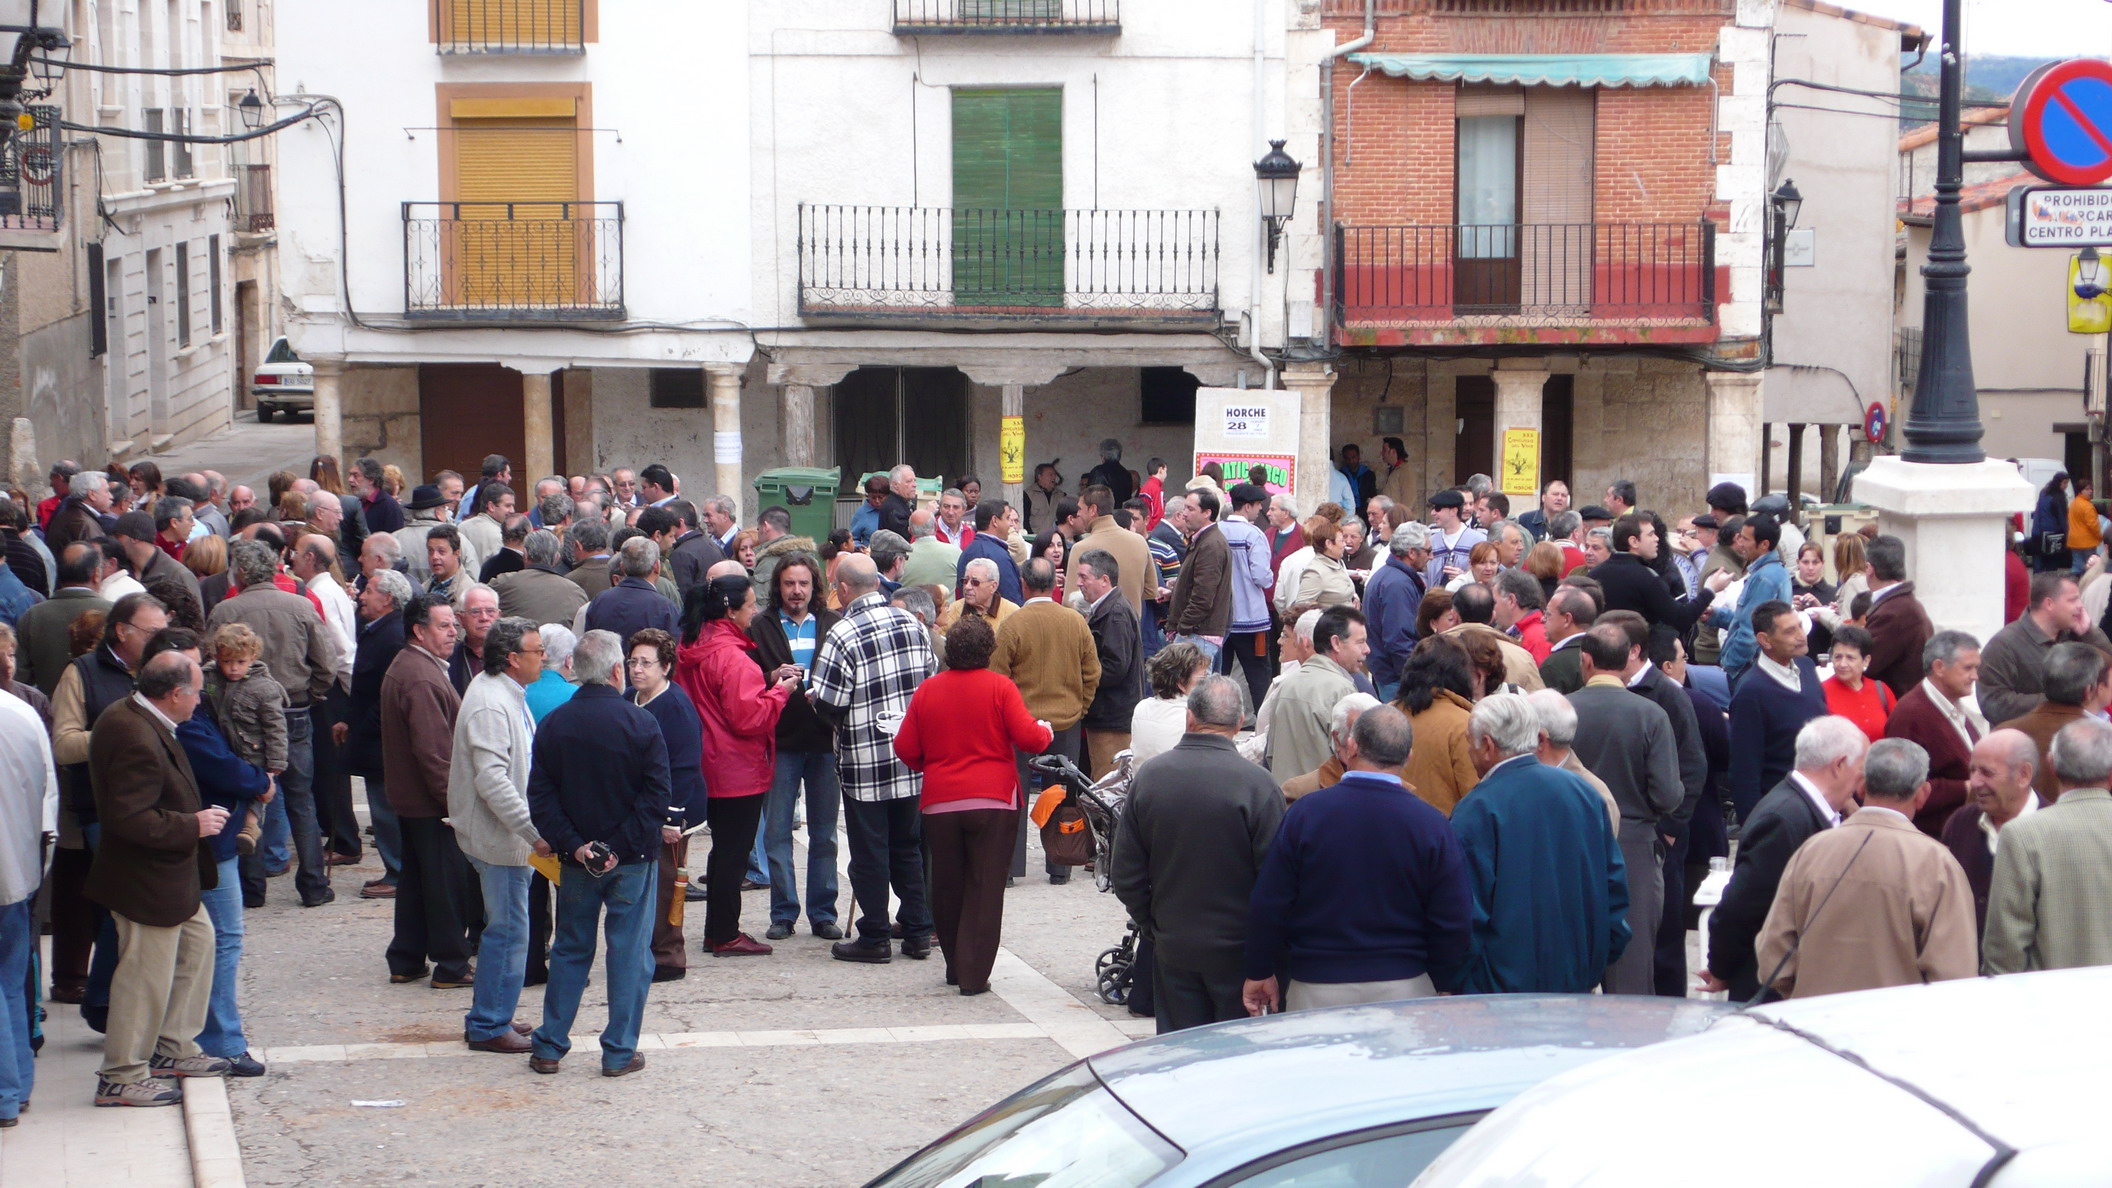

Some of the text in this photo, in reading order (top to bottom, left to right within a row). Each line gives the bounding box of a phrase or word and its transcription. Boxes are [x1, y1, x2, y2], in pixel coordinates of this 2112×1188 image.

[2044, 194, 2112, 206] PROHIBID
[2029, 226, 2084, 238] CENTRO
[1226, 408, 1266, 418] HORCHE
[1227, 421, 1247, 430] 28
